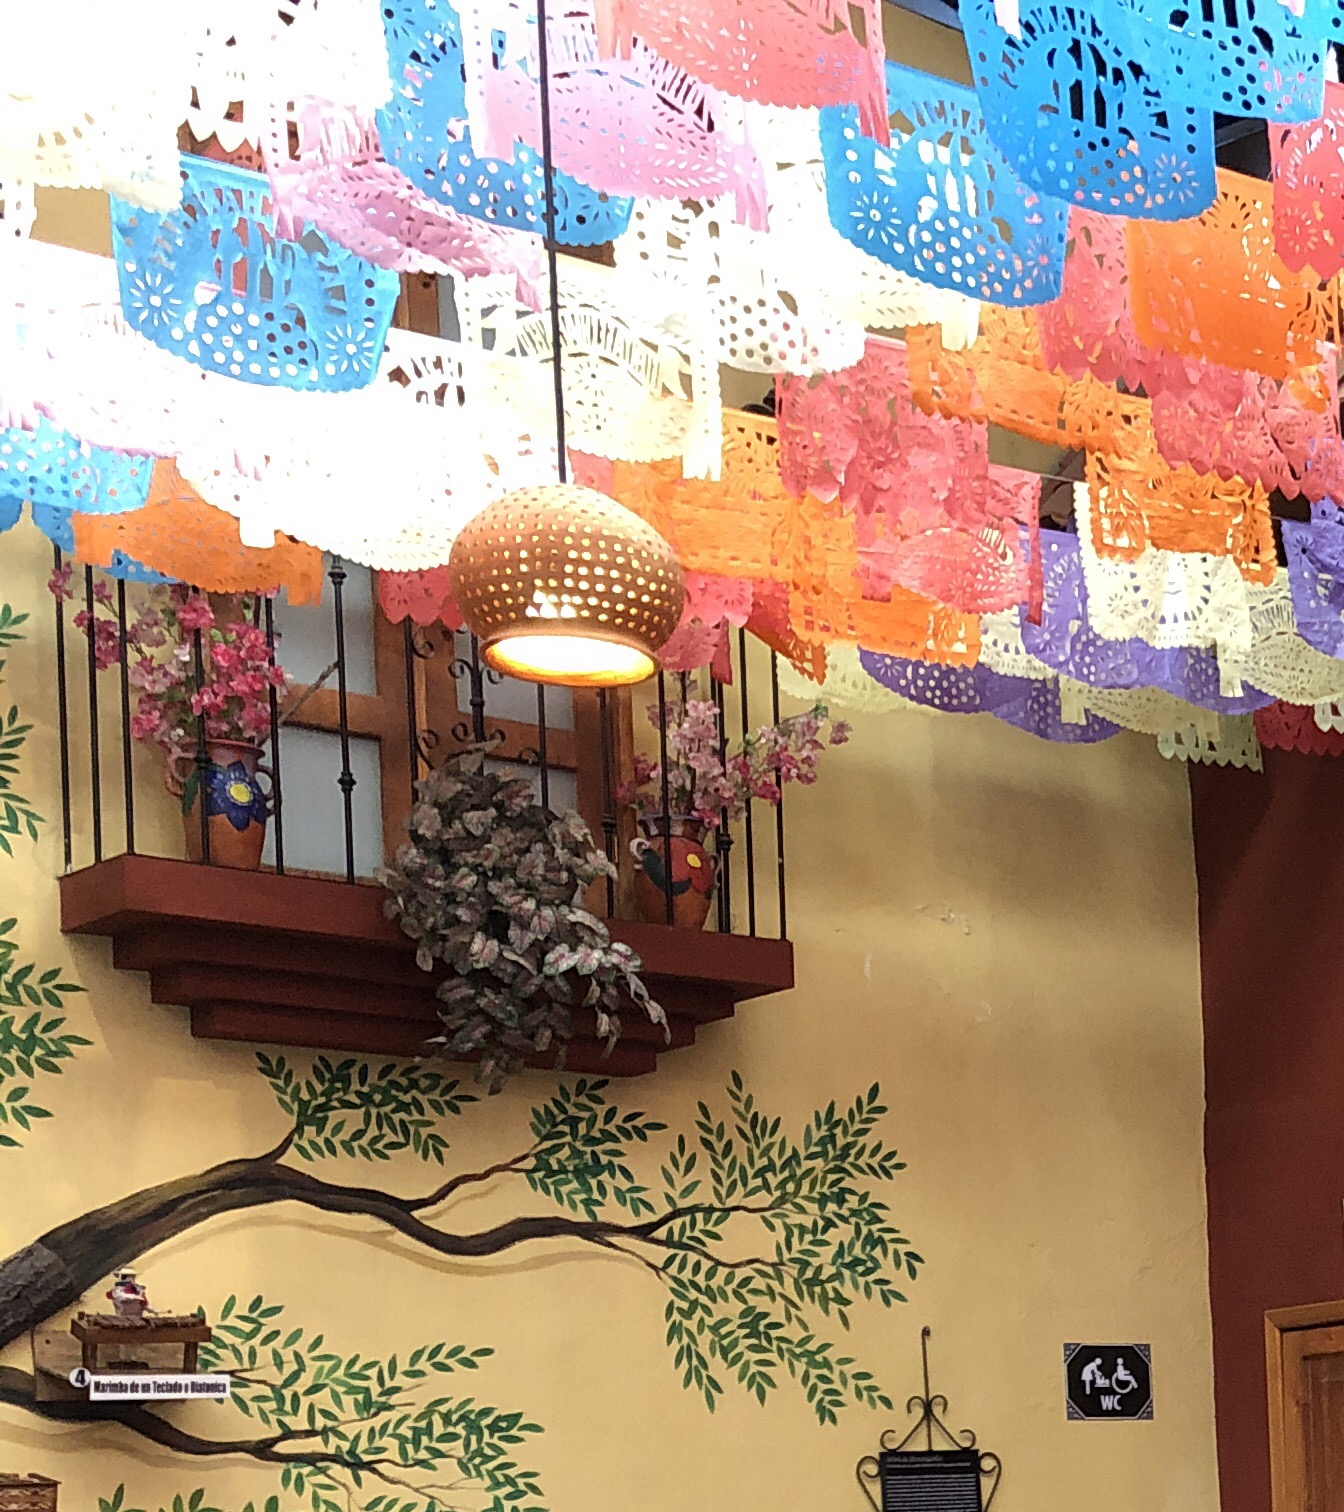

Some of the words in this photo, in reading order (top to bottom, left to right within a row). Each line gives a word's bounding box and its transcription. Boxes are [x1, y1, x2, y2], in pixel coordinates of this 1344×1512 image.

[75, 1369, 86, 1386] 4
[93, 1380, 129, 1394] Marimba
[129, 1381, 140, 1393] de
[141, 1382, 152, 1394] un
[152, 1381, 183, 1394] Teclado
[1100, 1394, 1122, 1411] WC
